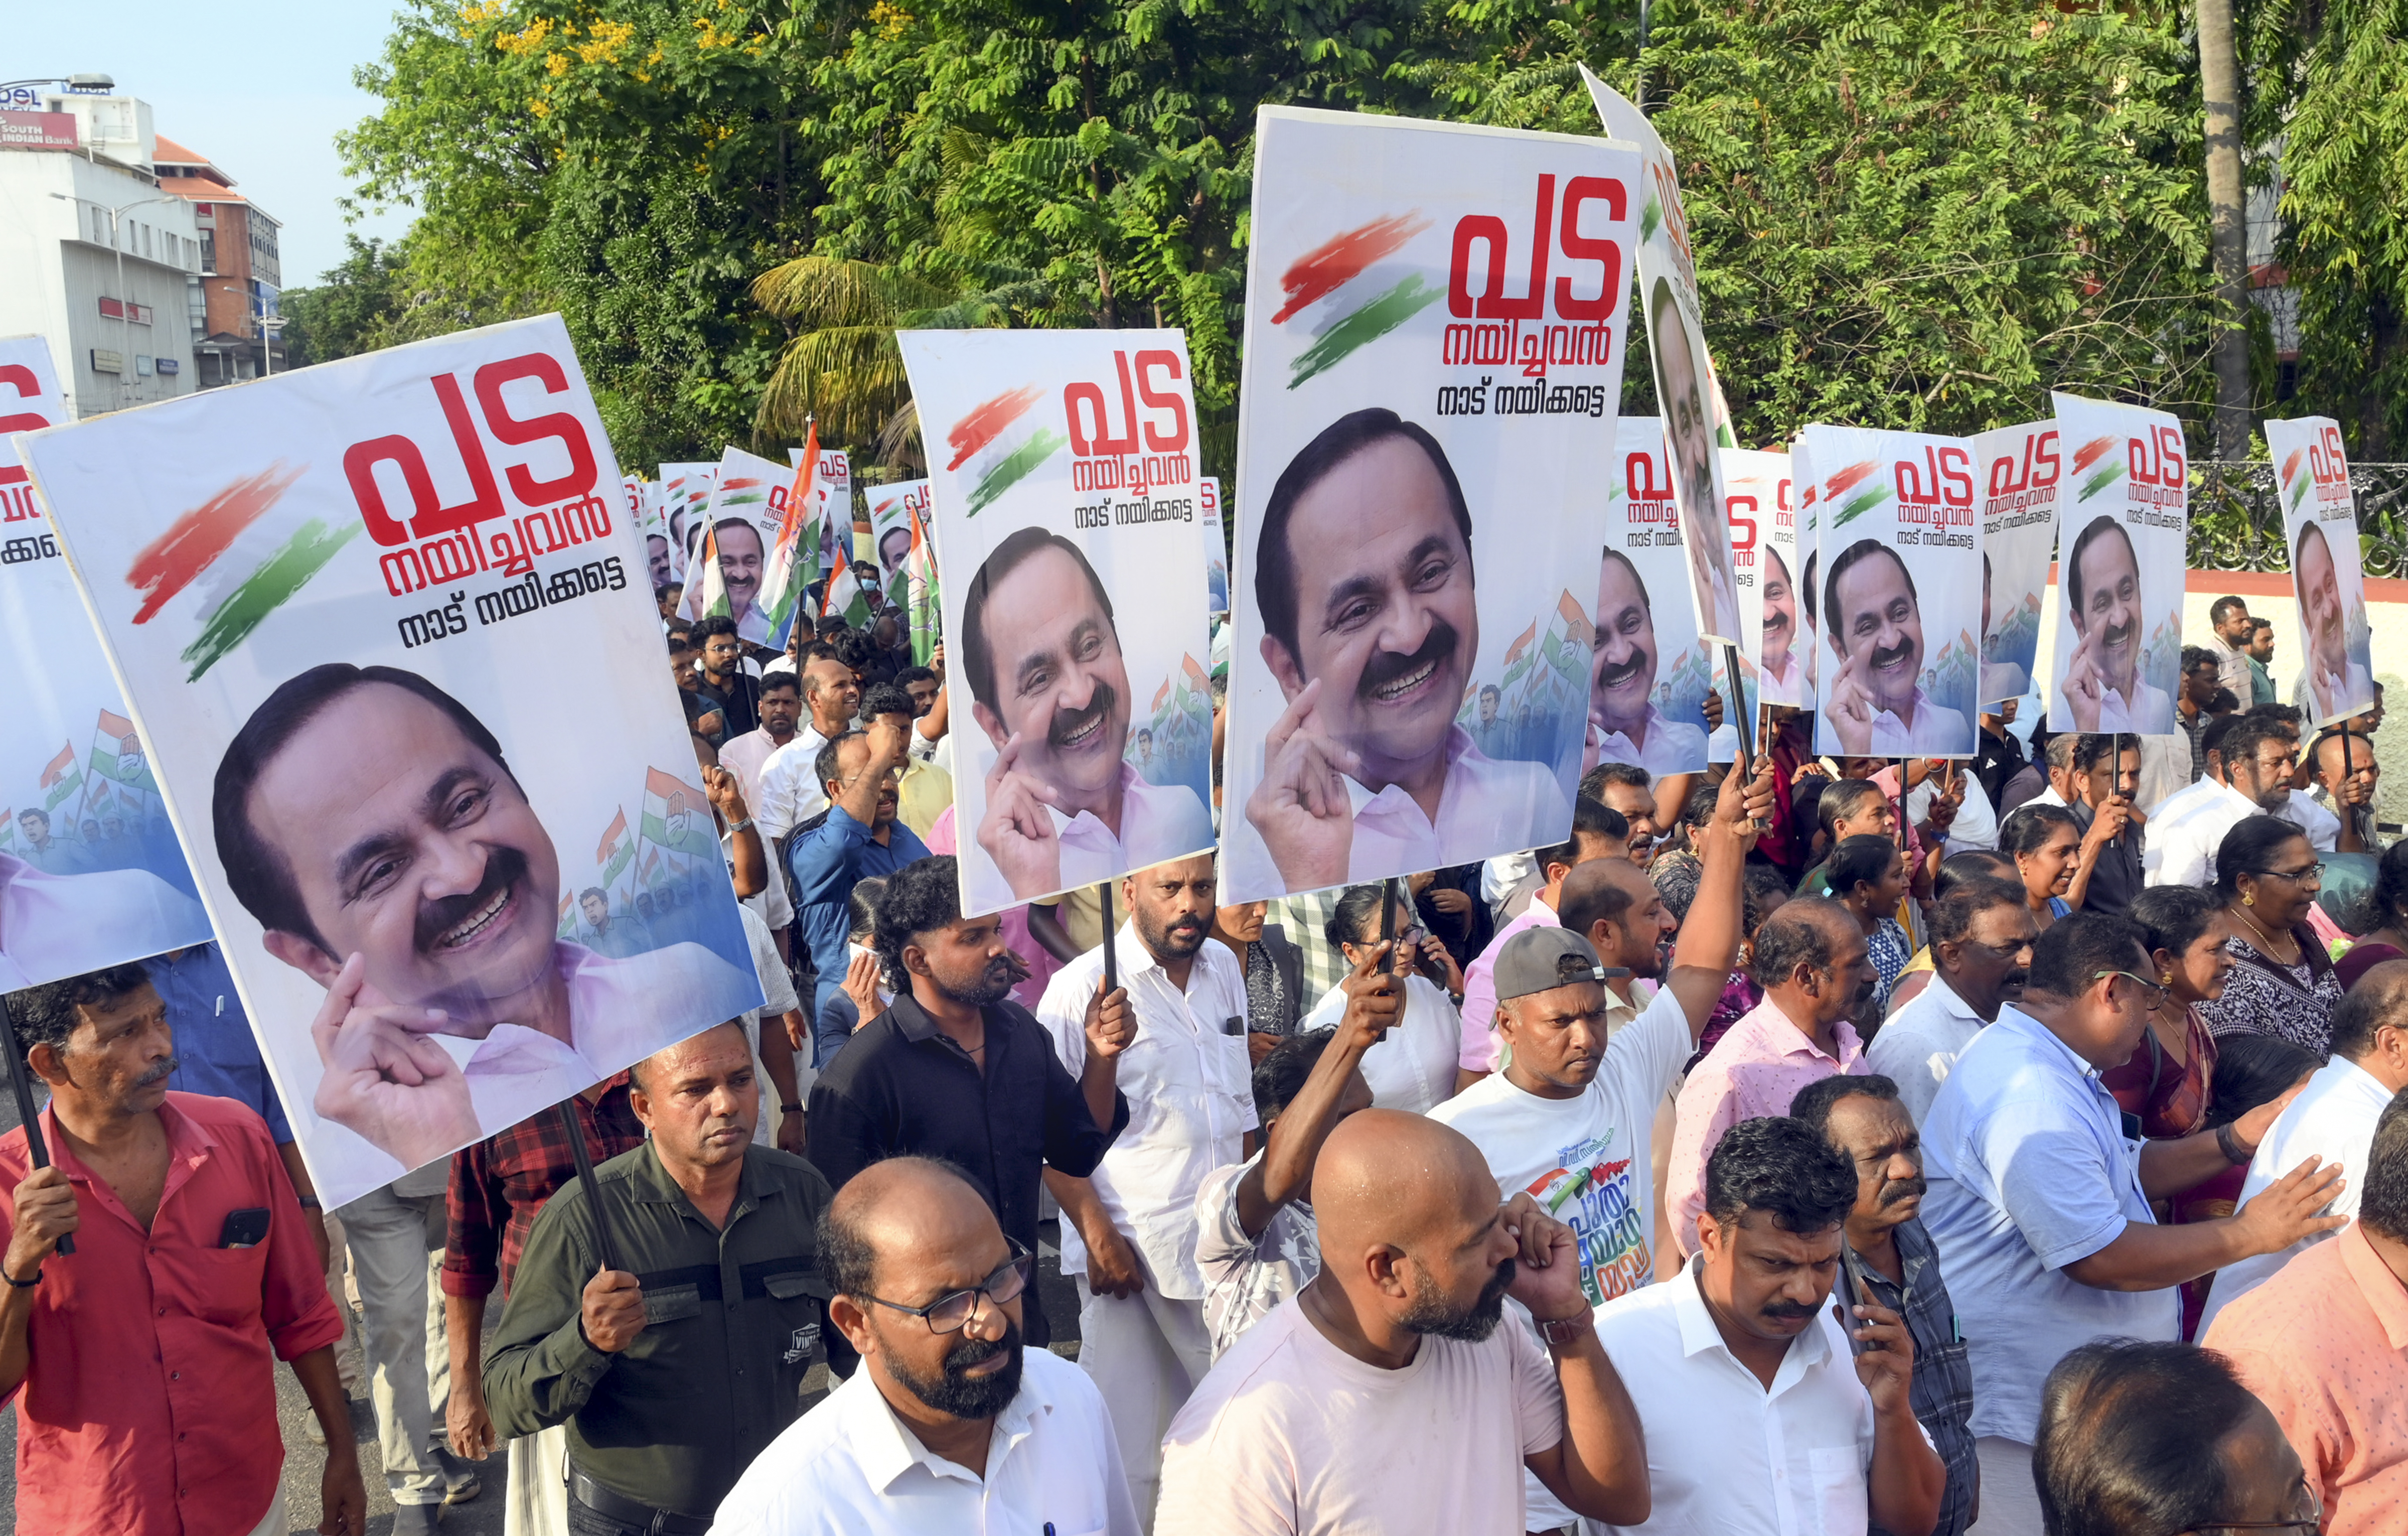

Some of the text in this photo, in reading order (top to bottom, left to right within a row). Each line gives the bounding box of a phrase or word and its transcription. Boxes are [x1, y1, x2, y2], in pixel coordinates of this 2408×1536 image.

[2, 125, 42, 134] SOUTH
[3, 134, 74, 145] INDIAN Bank
[1448, 173, 1627, 321] പട
[1443, 318, 1611, 377] നയിച്ചവൻ
[1064, 350, 1189, 457] പട
[1437, 376, 1605, 417] നാട് നയിക്കട്ടെ
[343, 352, 598, 546] പട
[1073, 451, 1191, 496] നയിച്ചവൻ
[1626, 433, 1675, 500] പ
[1894, 445, 1974, 507] പട
[1989, 430, 2060, 497] പട
[2129, 424, 2184, 488] പട
[2309, 427, 2346, 484] പട
[1075, 496, 1192, 528] നാട് നയിക്കട്ടെ
[1898, 503, 1974, 530] നയിച്ചവൻ
[1985, 485, 2056, 516] നയിച്ചവൻ
[379, 491, 612, 597] നയിച്ചവൻ
[1627, 527, 1653, 547] നാട്
[1897, 528, 1974, 549] നാട് നയിക്കട്ടെ
[398, 556, 627, 648] നാട് നയിക്കട്ടെ
